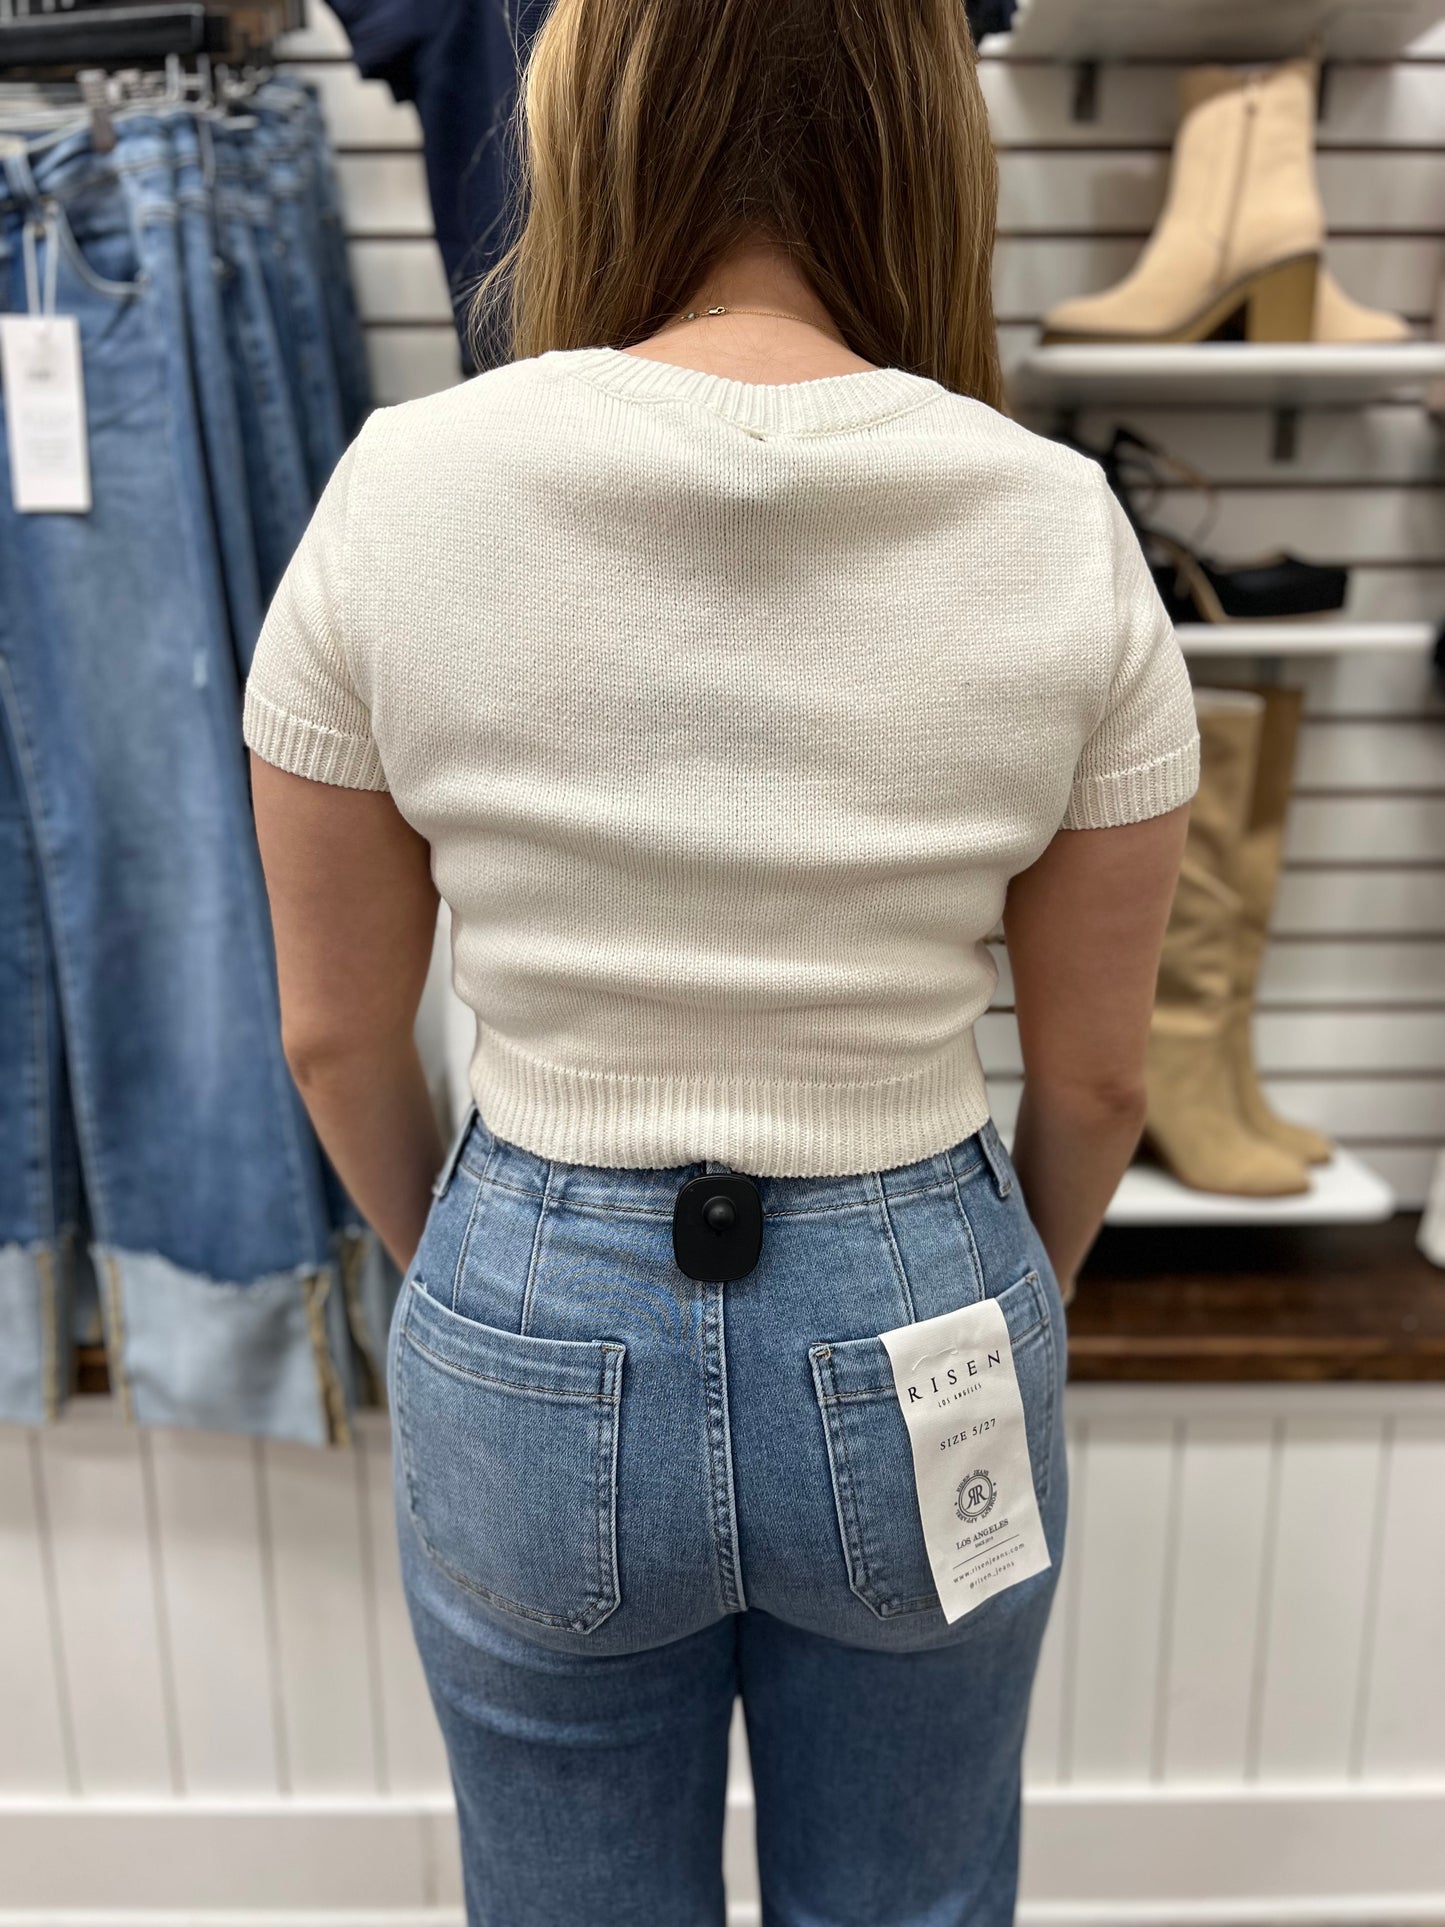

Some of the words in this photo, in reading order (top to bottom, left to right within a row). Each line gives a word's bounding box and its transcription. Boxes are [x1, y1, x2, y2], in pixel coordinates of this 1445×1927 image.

[907, 1350, 1001, 1403] RISEN
[938, 1398, 950, 1408] LOS
[954, 1383, 982, 1400] ANGELES
[940, 1431, 967, 1450] SIZE
[972, 1418, 996, 1435] 5/27
[956, 1537, 971, 1550] LOS
[973, 1518, 1009, 1542] ANGELES
